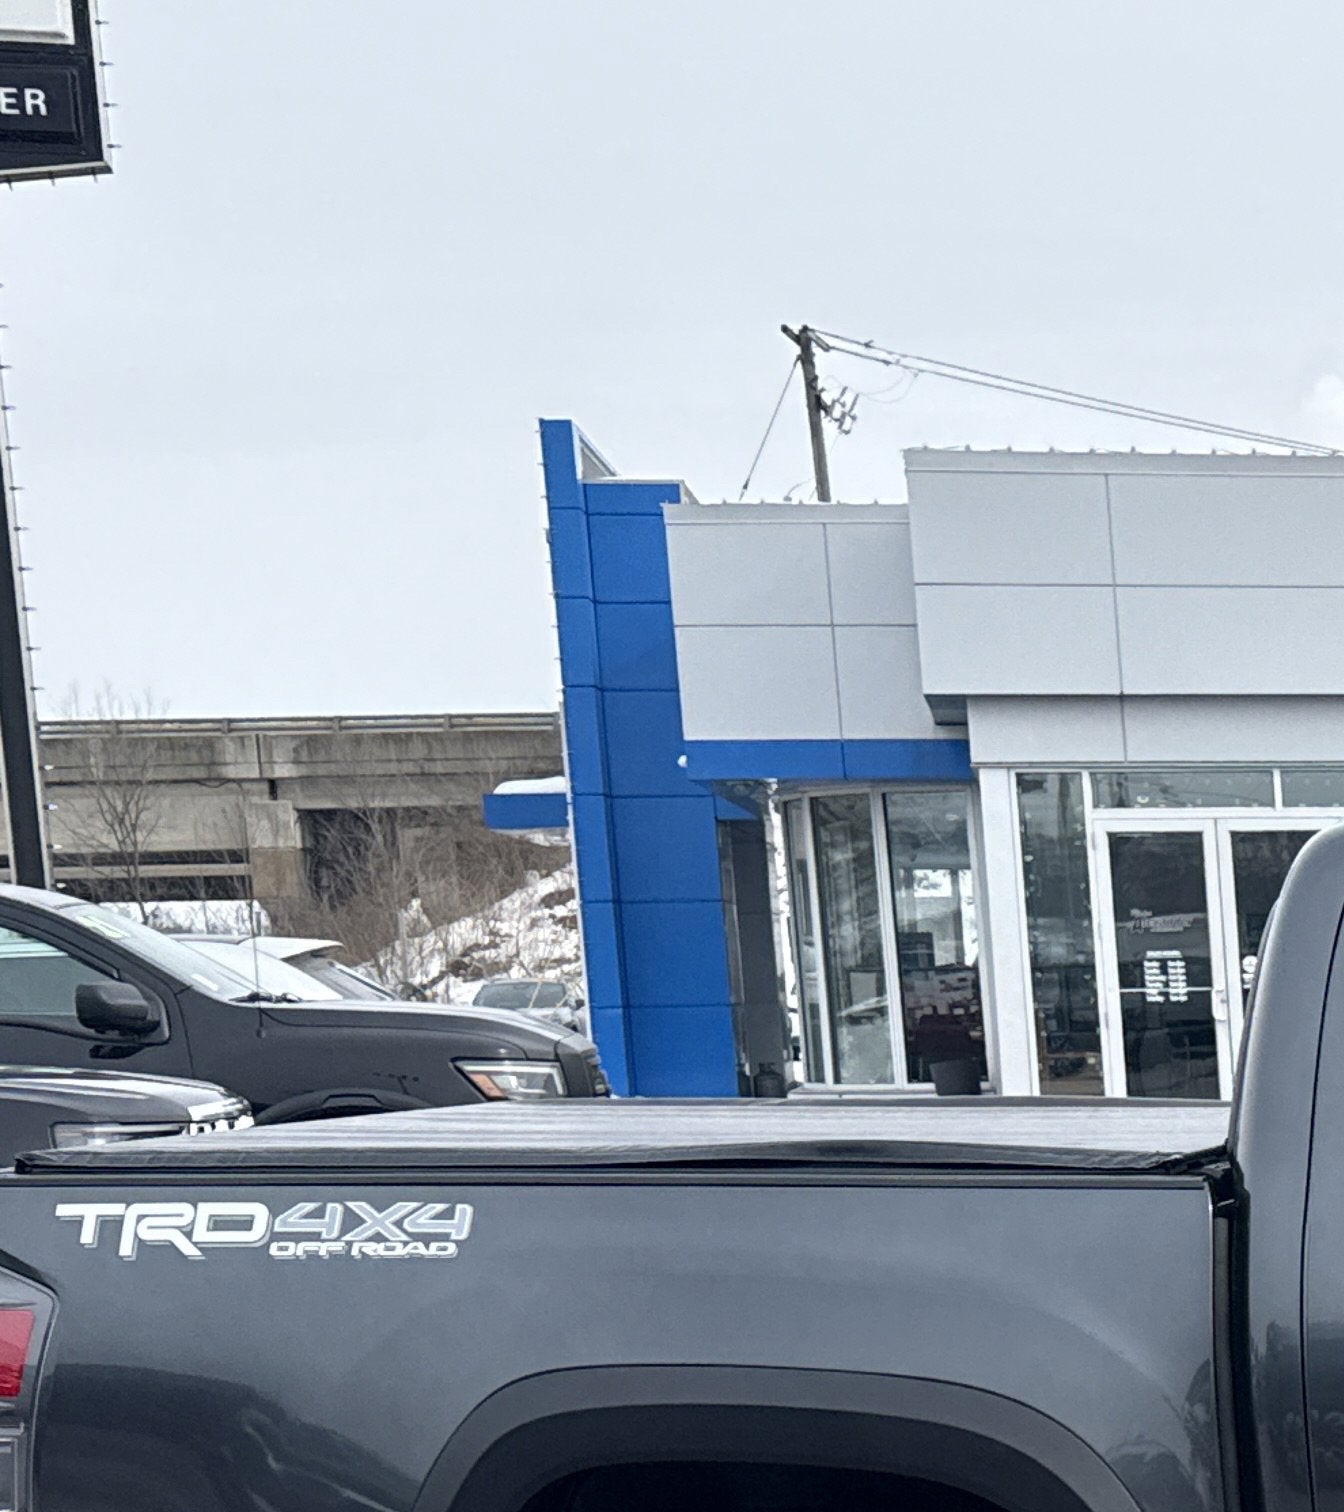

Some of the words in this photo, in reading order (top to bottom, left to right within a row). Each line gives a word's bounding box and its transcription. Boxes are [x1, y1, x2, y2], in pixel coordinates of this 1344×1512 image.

[55, 1202, 272, 1260] TRD
[269, 1241, 348, 1259] OFF
[351, 1241, 458, 1259] ROAD
